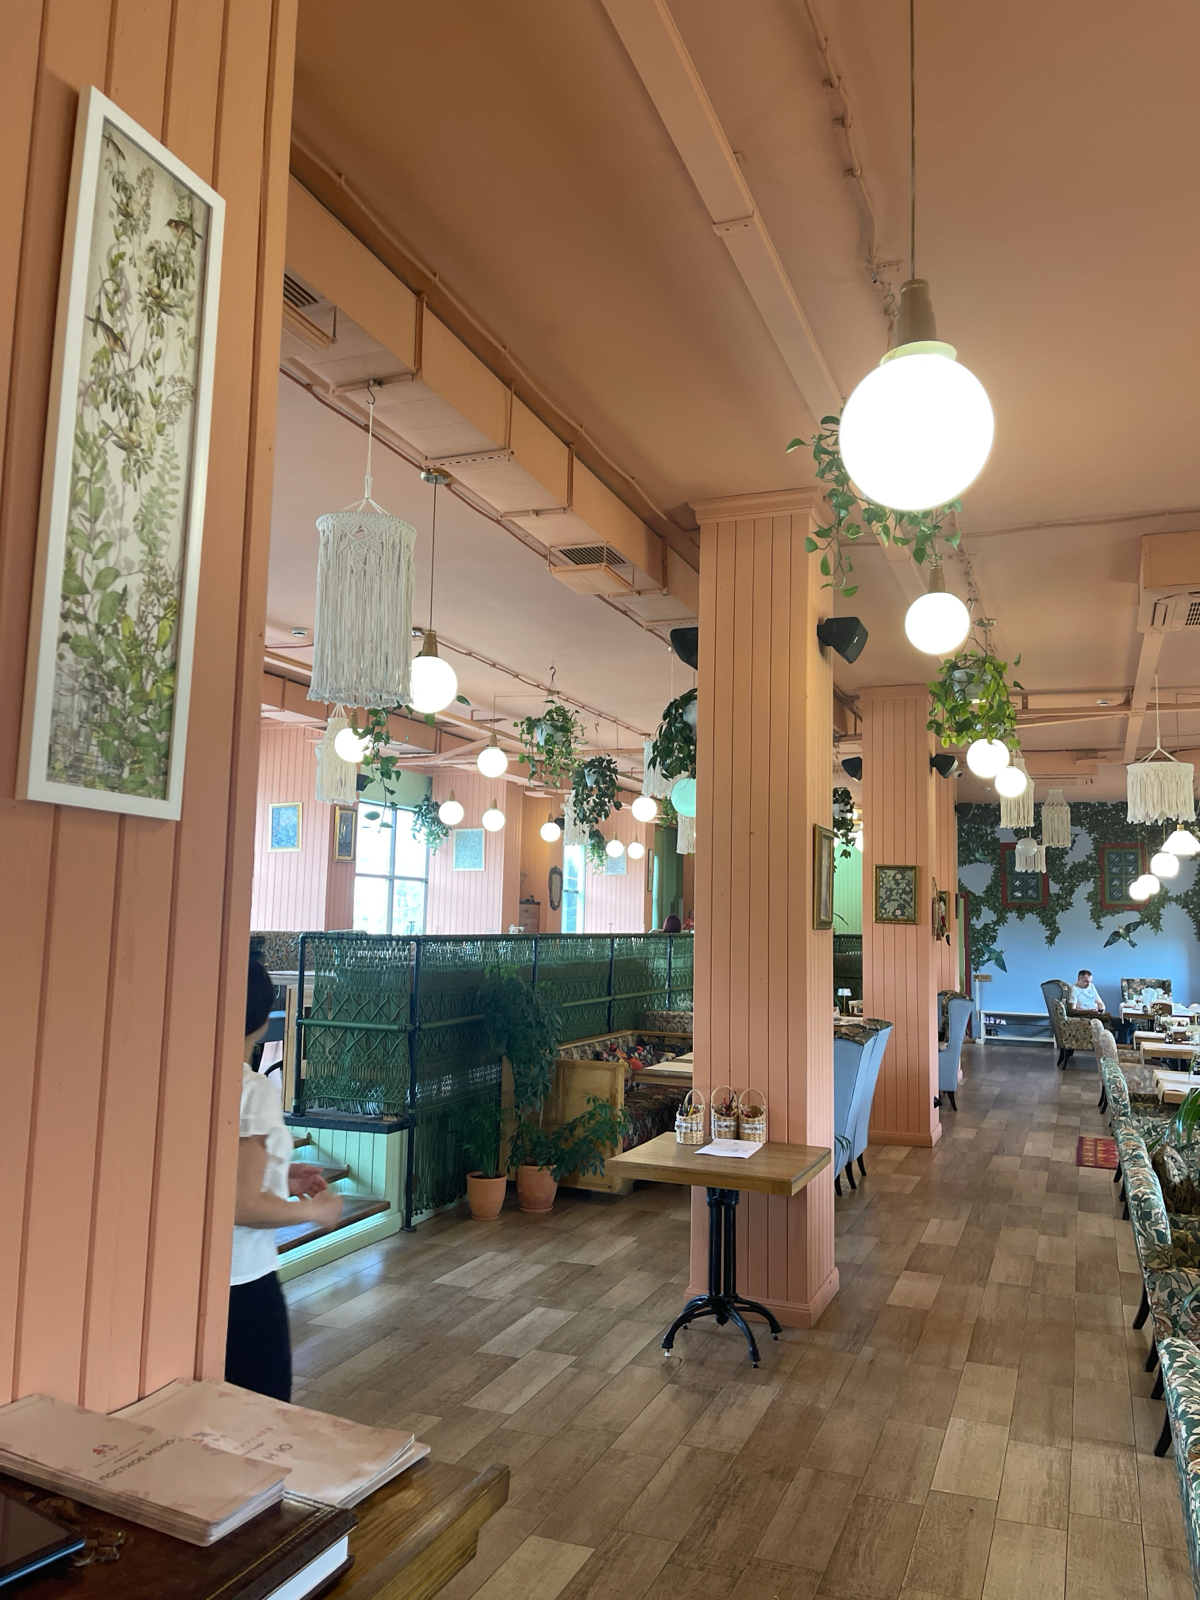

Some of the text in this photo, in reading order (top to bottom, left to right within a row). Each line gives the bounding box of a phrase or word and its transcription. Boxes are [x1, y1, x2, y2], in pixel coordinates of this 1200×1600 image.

[99, 1455, 147, 1483] ПОСТНОЕ
[145, 1438, 175, 1457] МЕНЮ
[262, 1443, 293, 1461] НЮ
